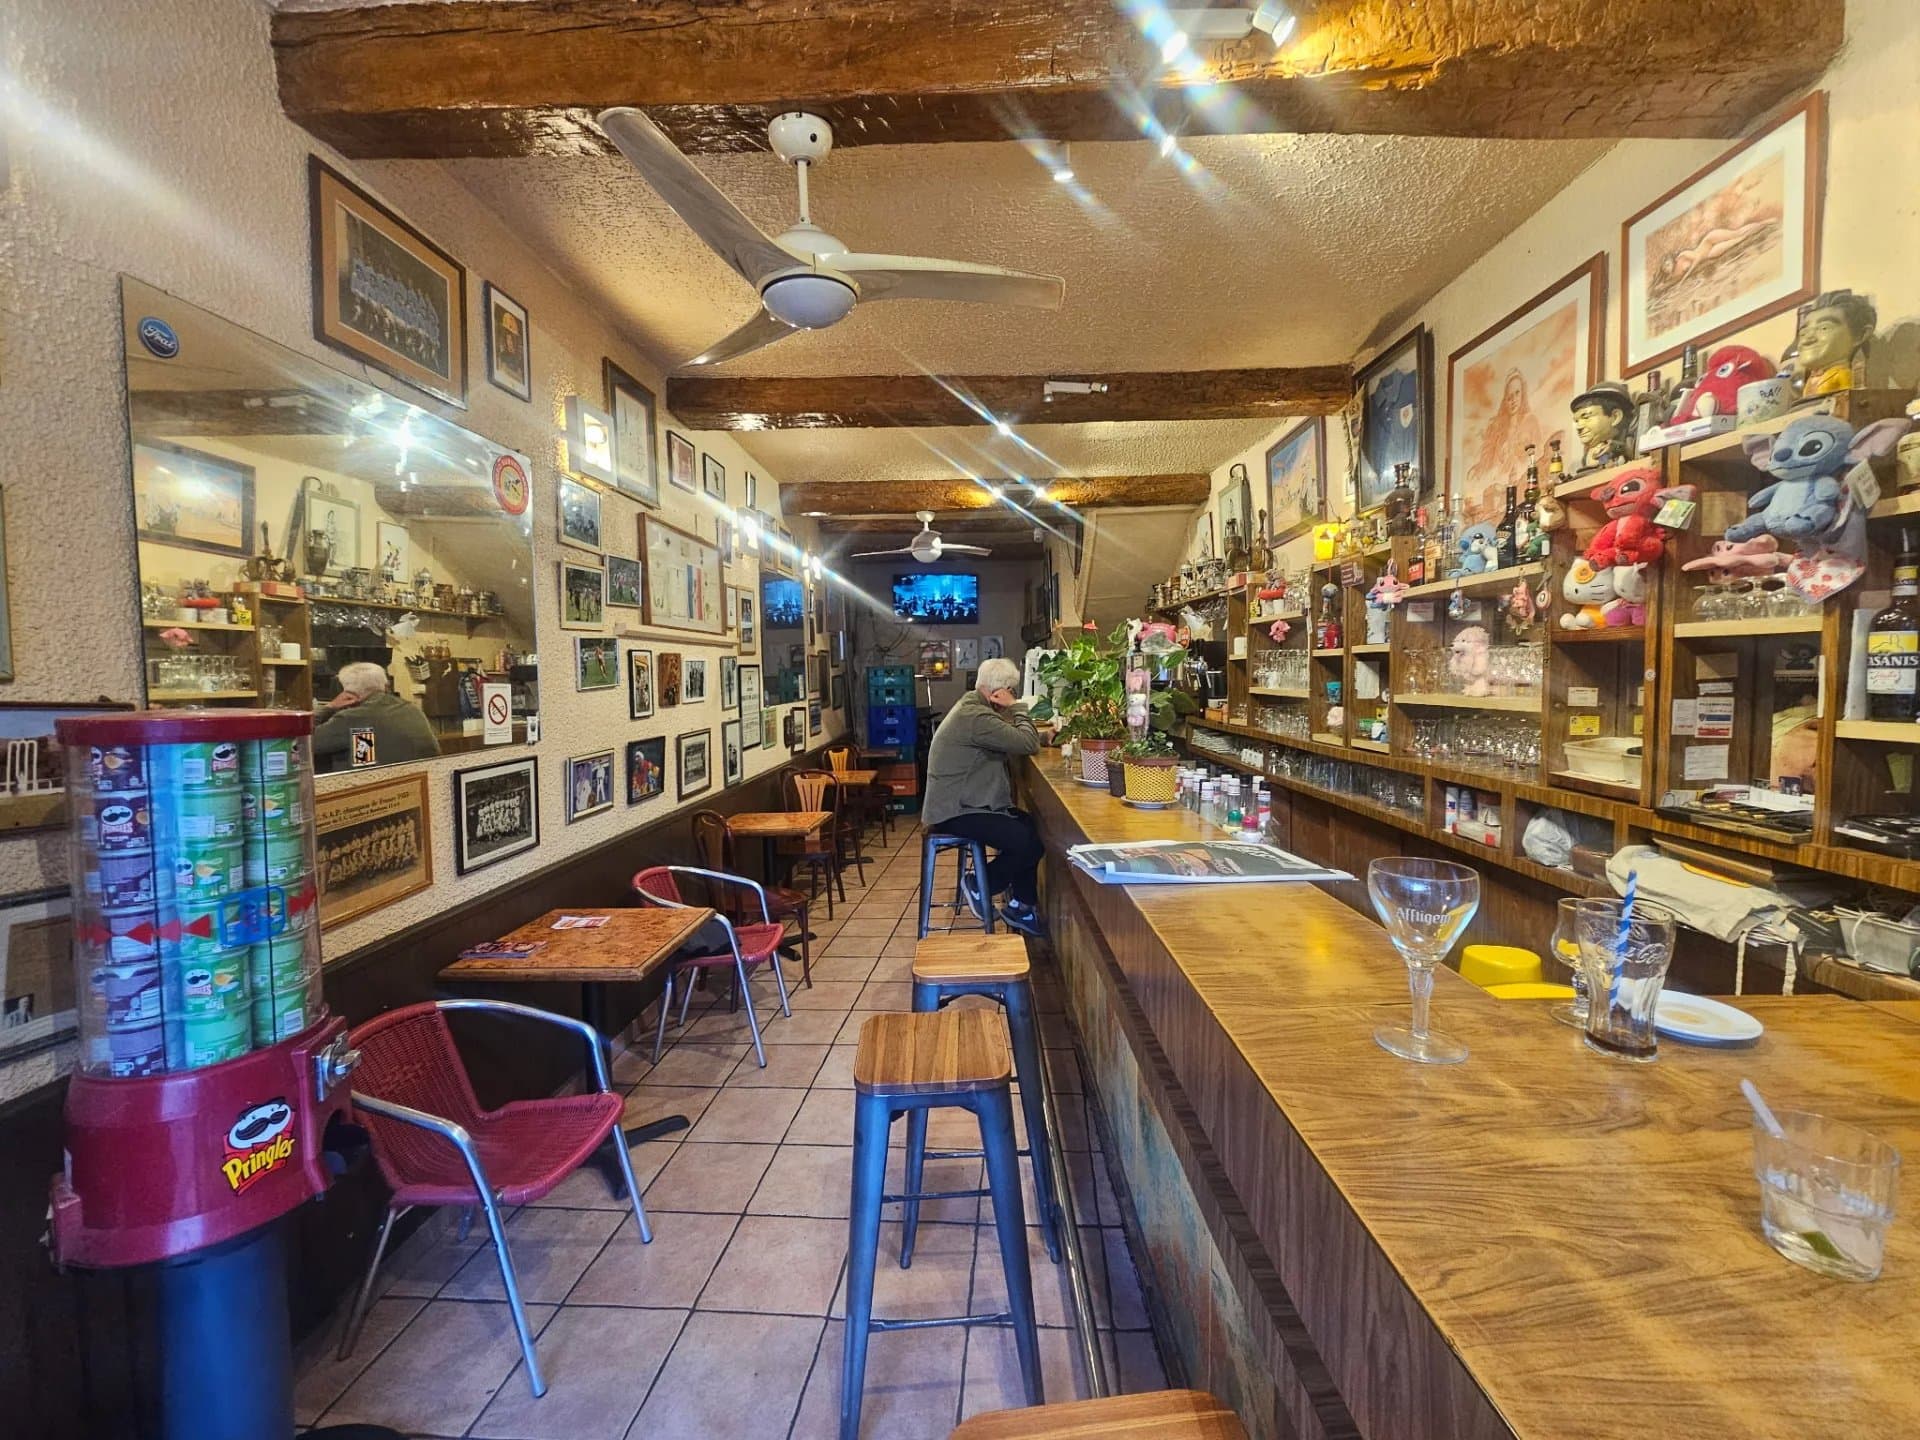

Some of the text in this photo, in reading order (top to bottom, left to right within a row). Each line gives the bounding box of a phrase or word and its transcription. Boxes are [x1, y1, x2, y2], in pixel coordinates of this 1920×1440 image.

[1867, 654, 1919, 667] ASANIS
[1397, 907, 1452, 926] Affligem
[222, 1134, 296, 1190] Pringles
